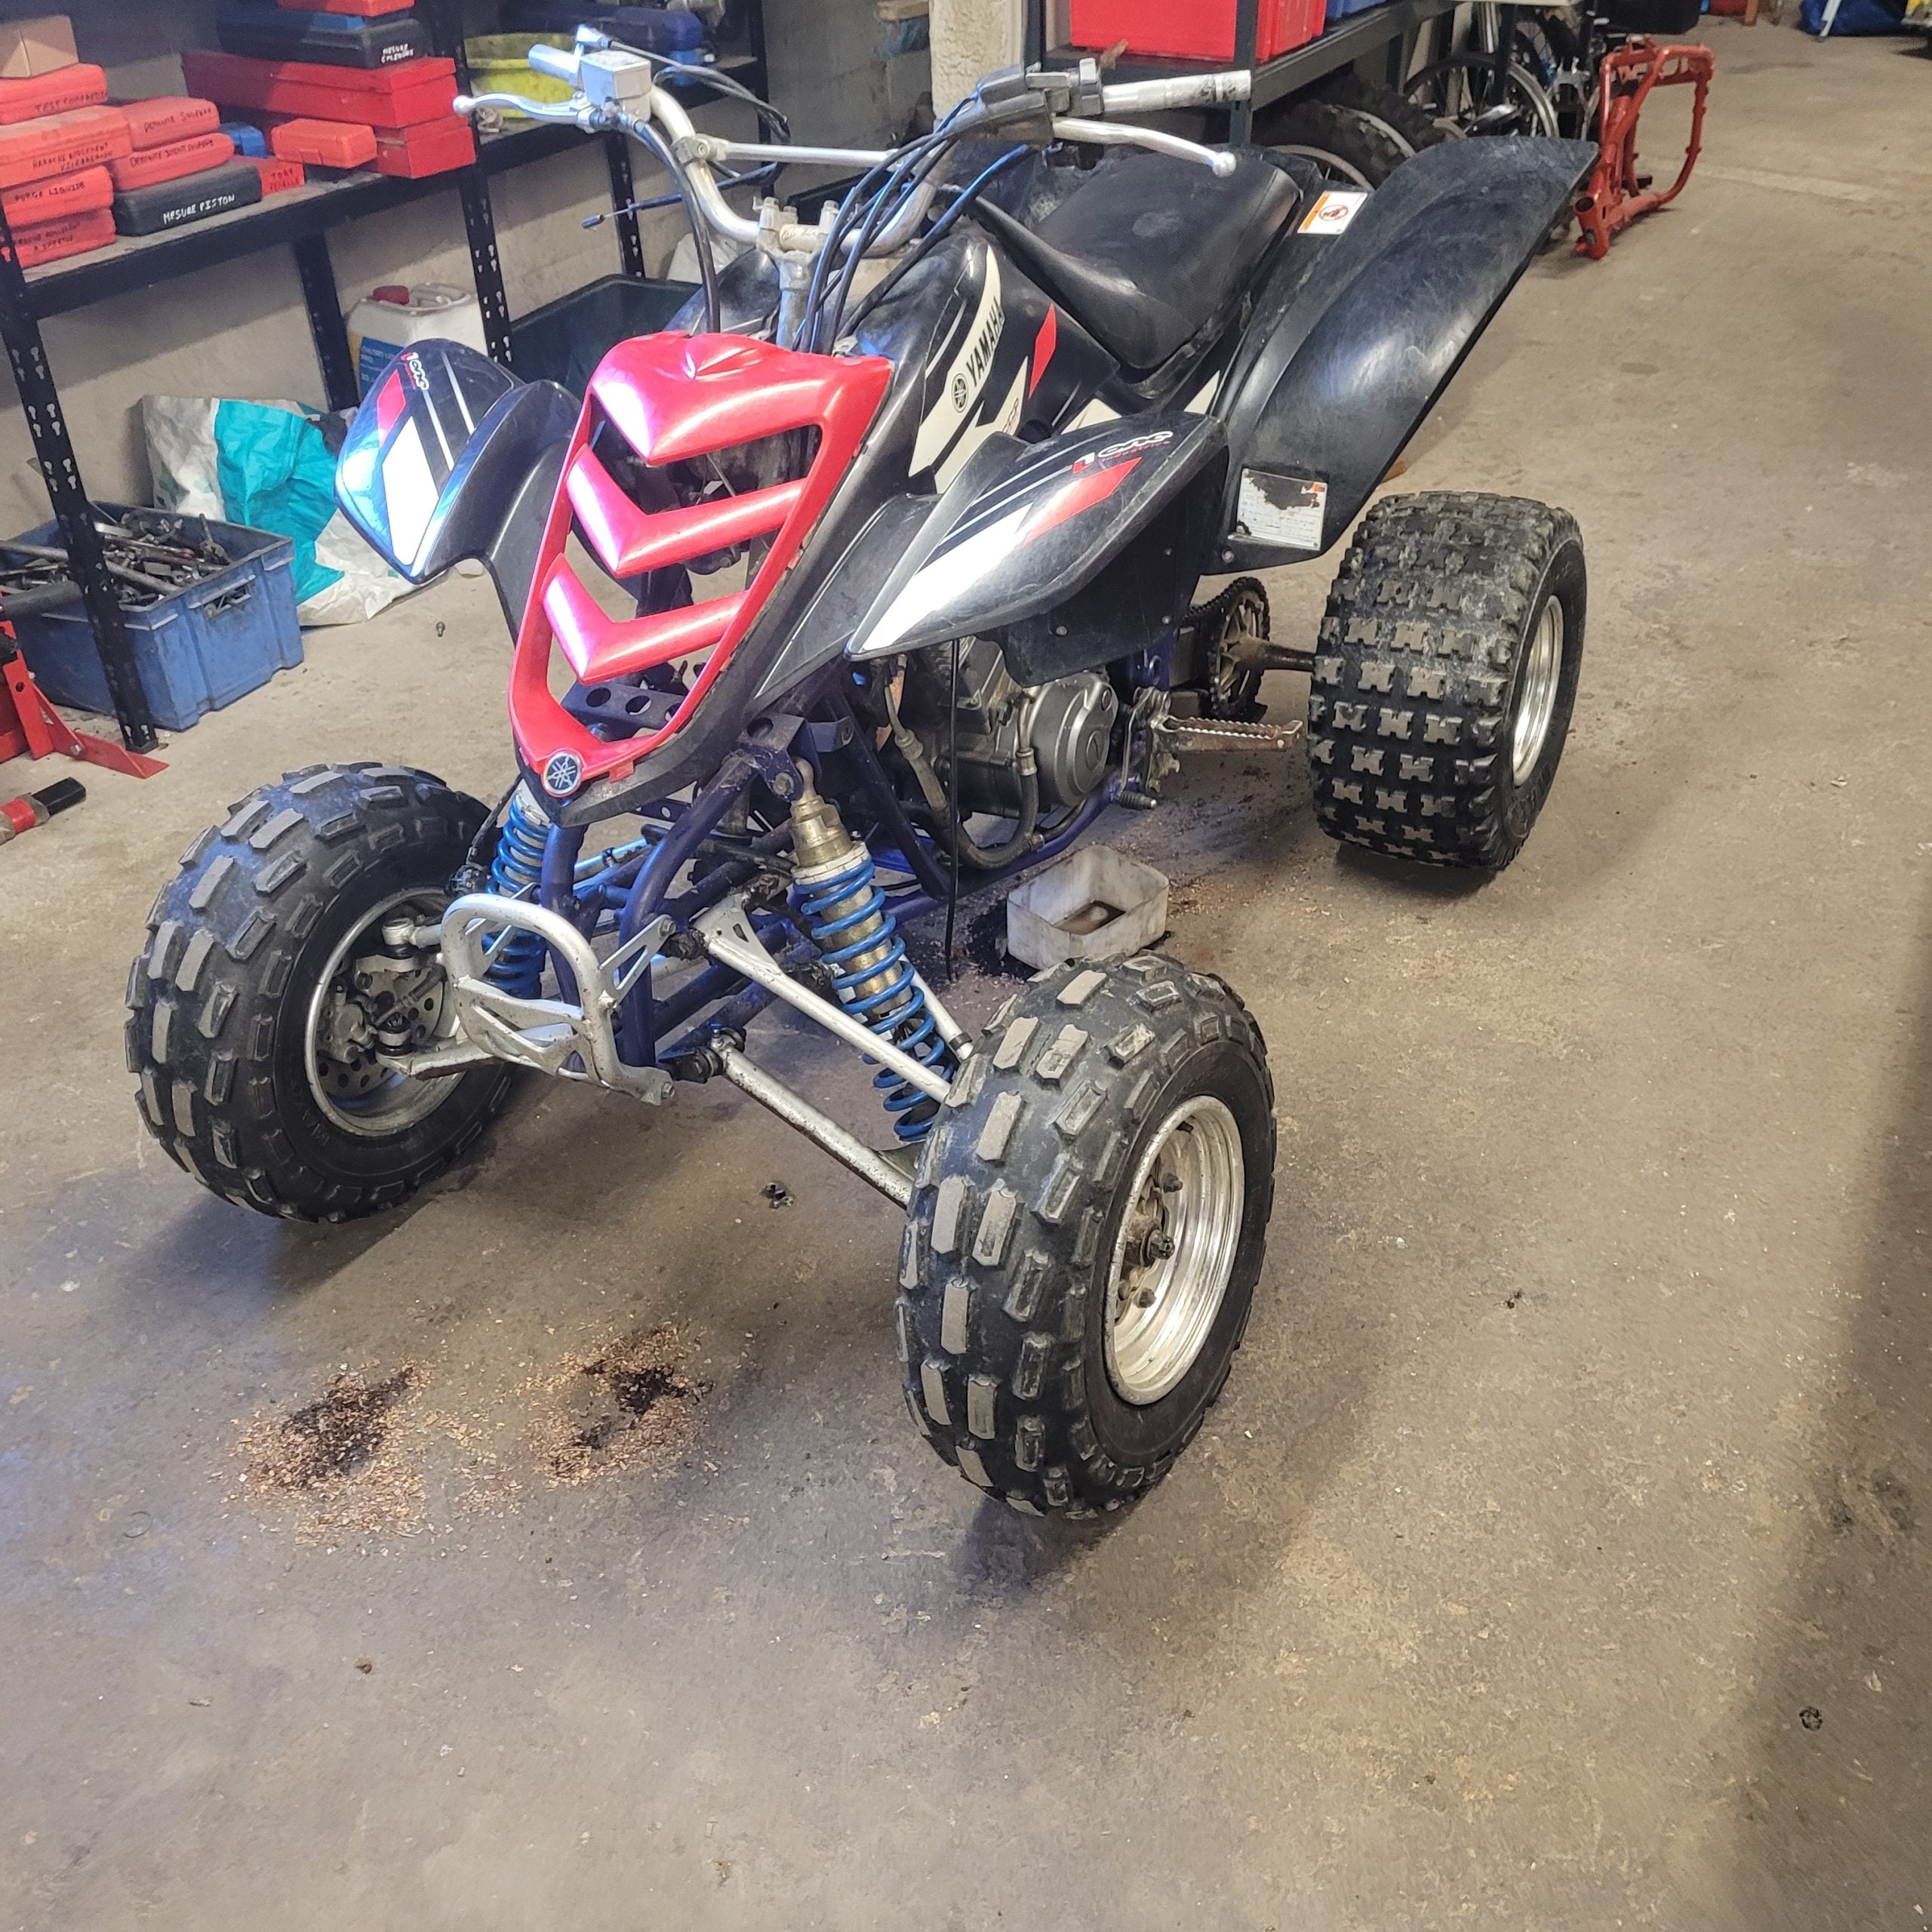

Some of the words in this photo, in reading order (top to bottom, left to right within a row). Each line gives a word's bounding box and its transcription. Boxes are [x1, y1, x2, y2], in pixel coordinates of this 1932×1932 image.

[163, 203, 196, 225] MESURE
[199, 194, 235, 212] PISTON
[966, 295, 1005, 387] YAMAHA
